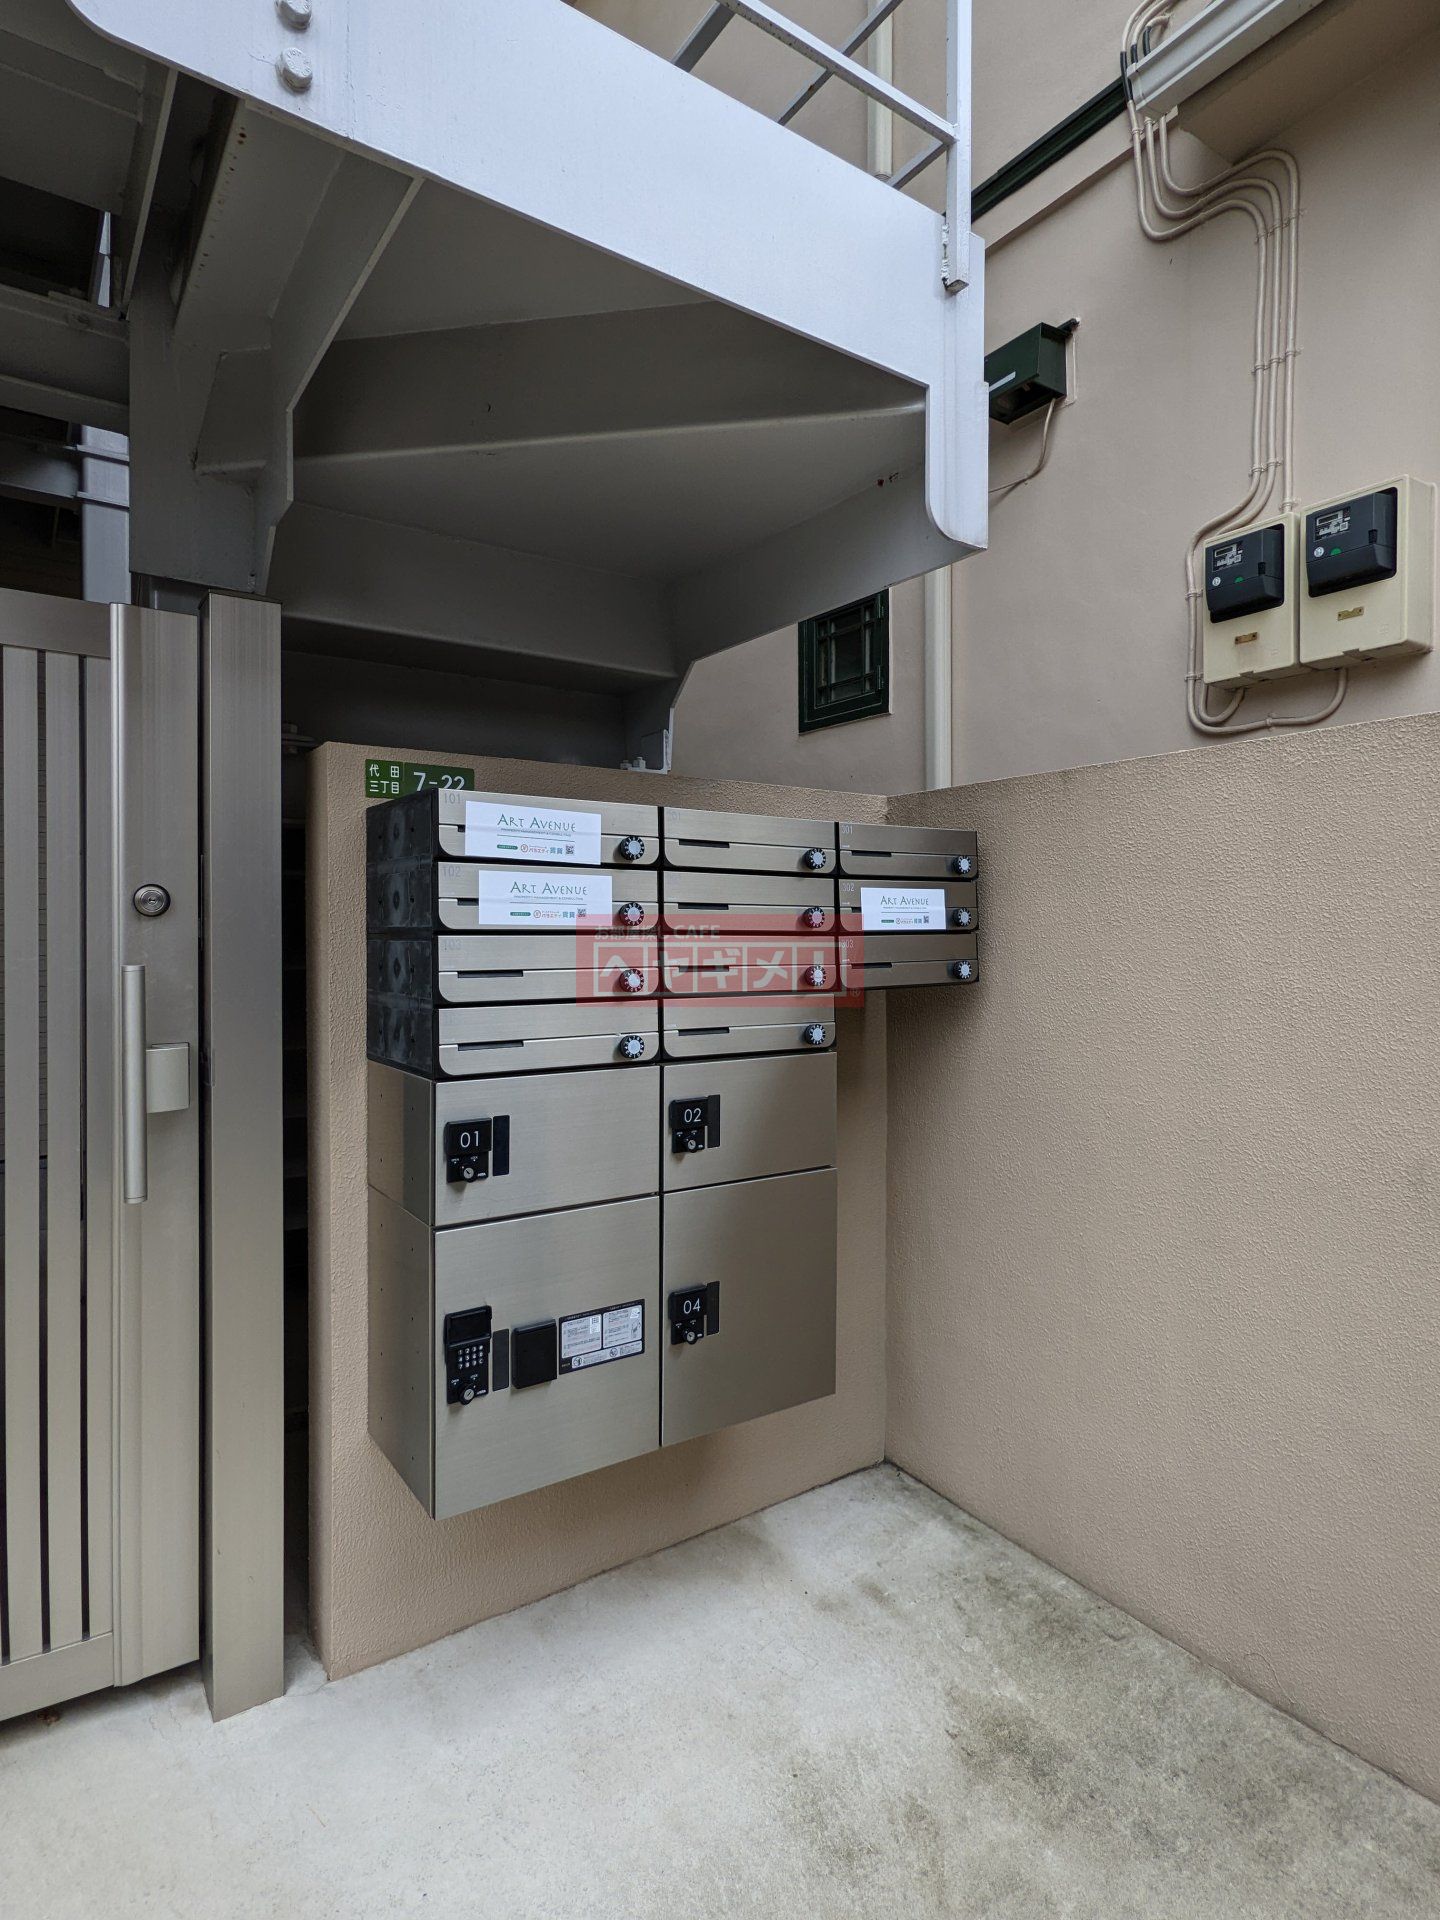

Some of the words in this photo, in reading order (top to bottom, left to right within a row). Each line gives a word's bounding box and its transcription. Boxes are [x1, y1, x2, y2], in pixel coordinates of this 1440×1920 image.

[369, 763, 400, 778] 代田
[369, 780, 400, 794] 三丁目
[413, 771, 466, 792] 7-22
[444, 793, 461, 806] 101
[497, 813, 524, 828] ART
[529, 816, 576, 833] AVENUE
[841, 825, 854, 835] 301
[510, 881, 537, 894] ART
[541, 881, 588, 896] AVENUE
[842, 882, 855, 892] 302
[684, 1107, 702, 1123] 02
[460, 1130, 479, 1148] 01
[683, 1297, 701, 1315] 04
